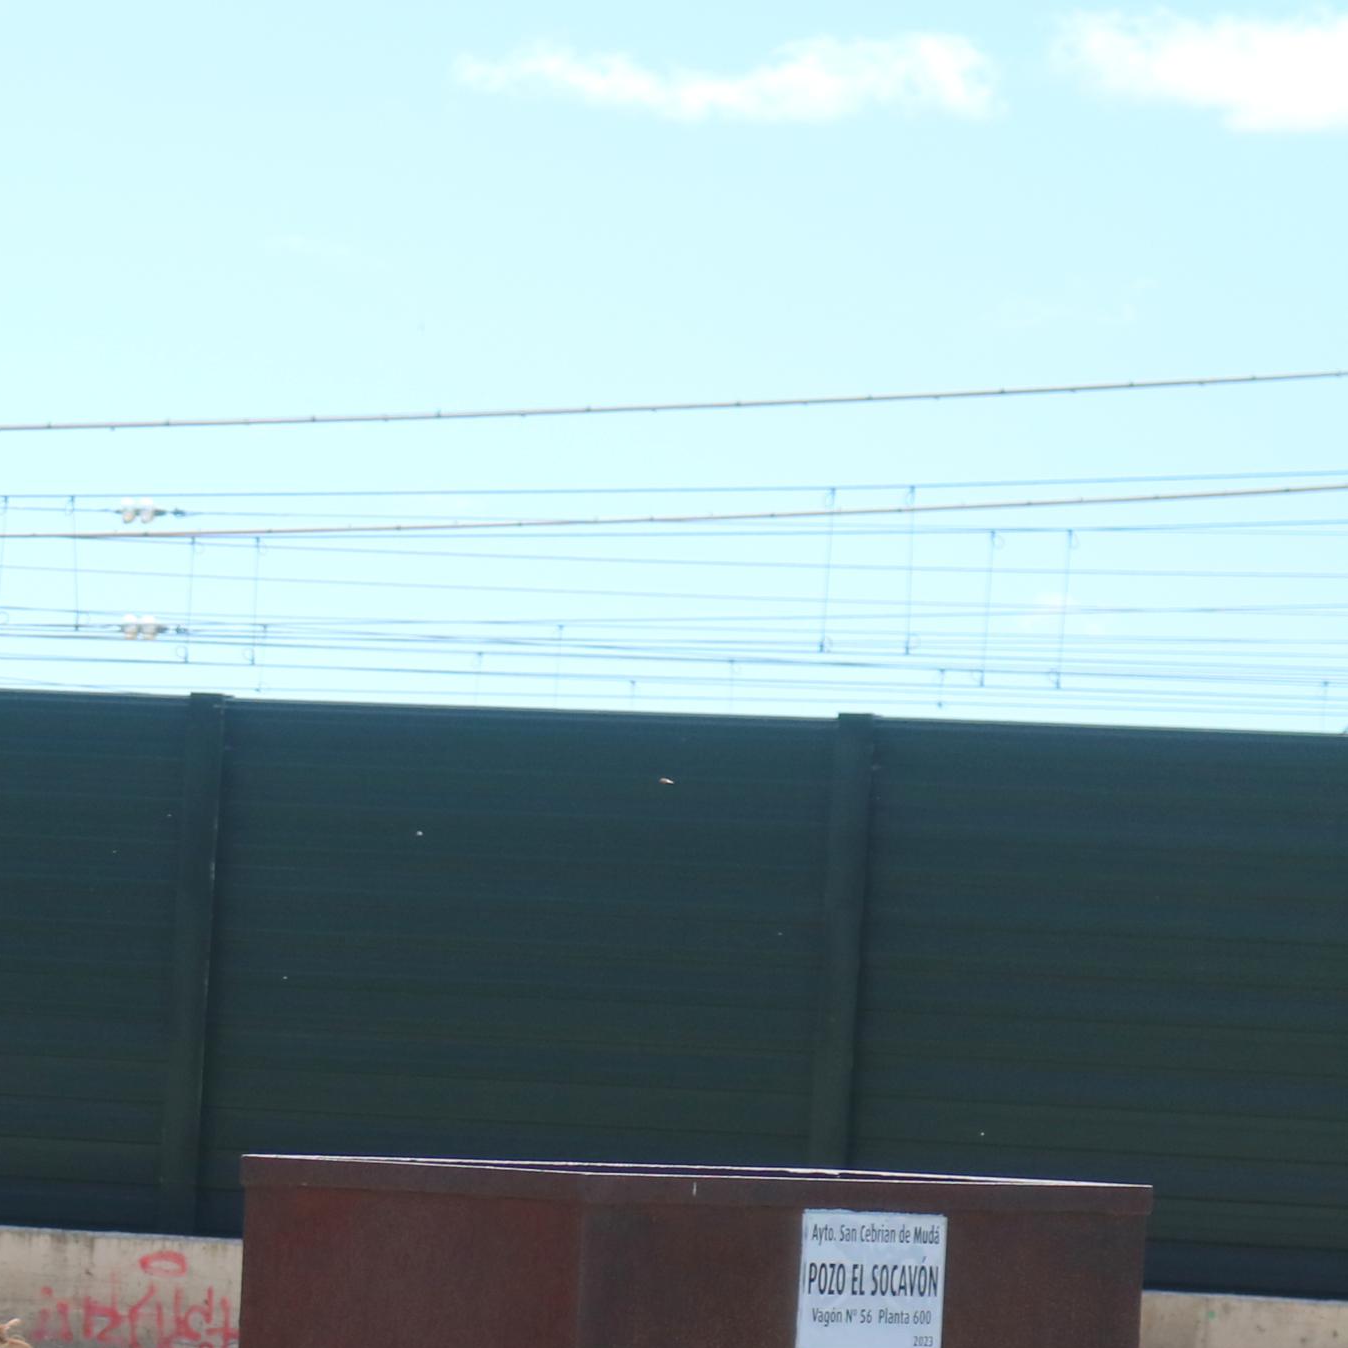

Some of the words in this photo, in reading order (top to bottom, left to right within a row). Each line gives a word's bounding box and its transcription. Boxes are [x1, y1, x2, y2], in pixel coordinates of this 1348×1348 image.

[812, 1224, 836, 1246] Ayto.
[840, 1224, 857, 1242] San
[899, 1225, 910, 1243] de
[913, 1225, 940, 1244] Mudá
[808, 1262, 846, 1295] POZO
[851, 1264, 865, 1296] EL
[871, 1256, 939, 1297] SOCAVÓN
[812, 1307, 843, 1327] Vagón
[860, 1309, 872, 1324] 56
[878, 1308, 910, 1324] Planta
[913, 1310, 931, 1325] 600
[913, 1336, 934, 1347] 2023
